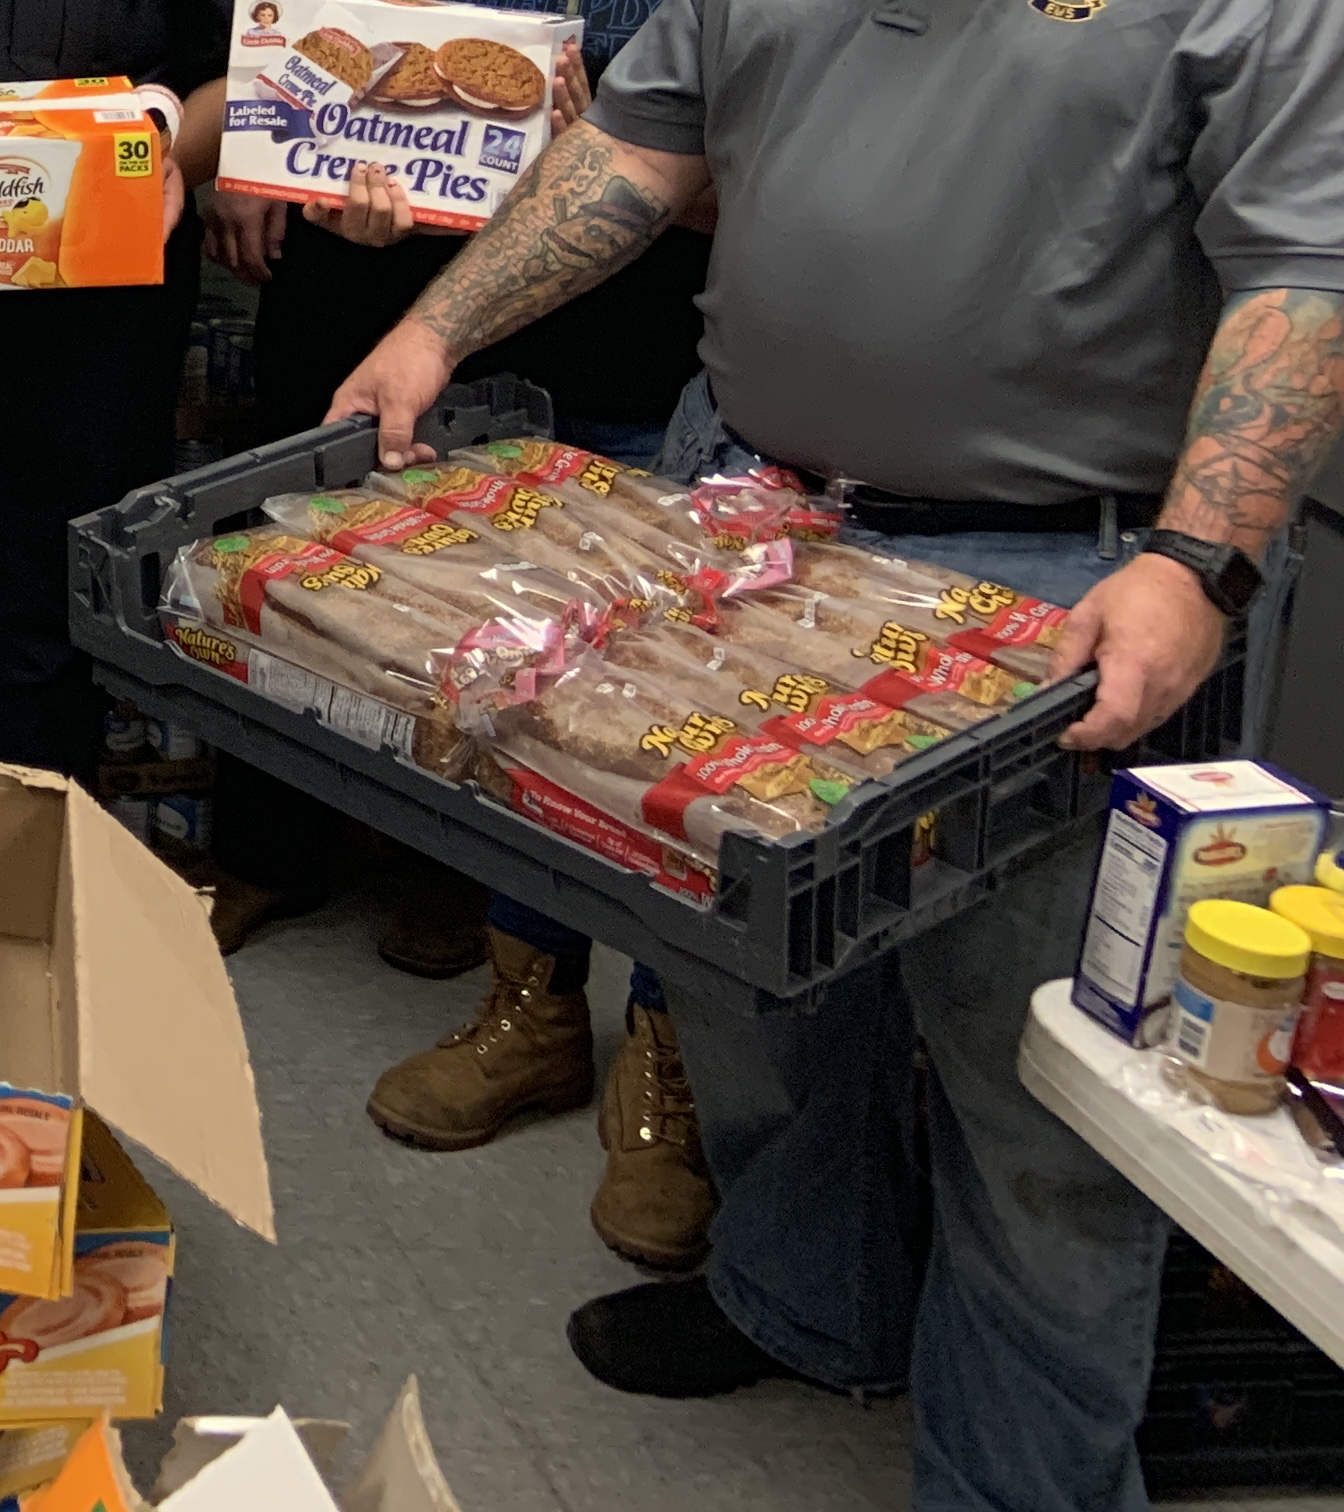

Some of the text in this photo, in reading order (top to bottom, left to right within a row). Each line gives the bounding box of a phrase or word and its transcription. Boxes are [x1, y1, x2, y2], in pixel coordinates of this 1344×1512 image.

[1044, 2, 1076, 19] EMS
[284, 54, 338, 96] Oatmeal
[228, 116, 288, 128] for Resale
[229, 105, 276, 117] Labeled
[315, 102, 471, 157] Oatmeal
[117, 140, 150, 162] 30
[486, 128, 524, 155] 24
[118, 164, 150, 174] PACKS
[479, 153, 519, 171] COUNT
[405, 158, 491, 203] Pies
[175, 627, 238, 662] Nature's
